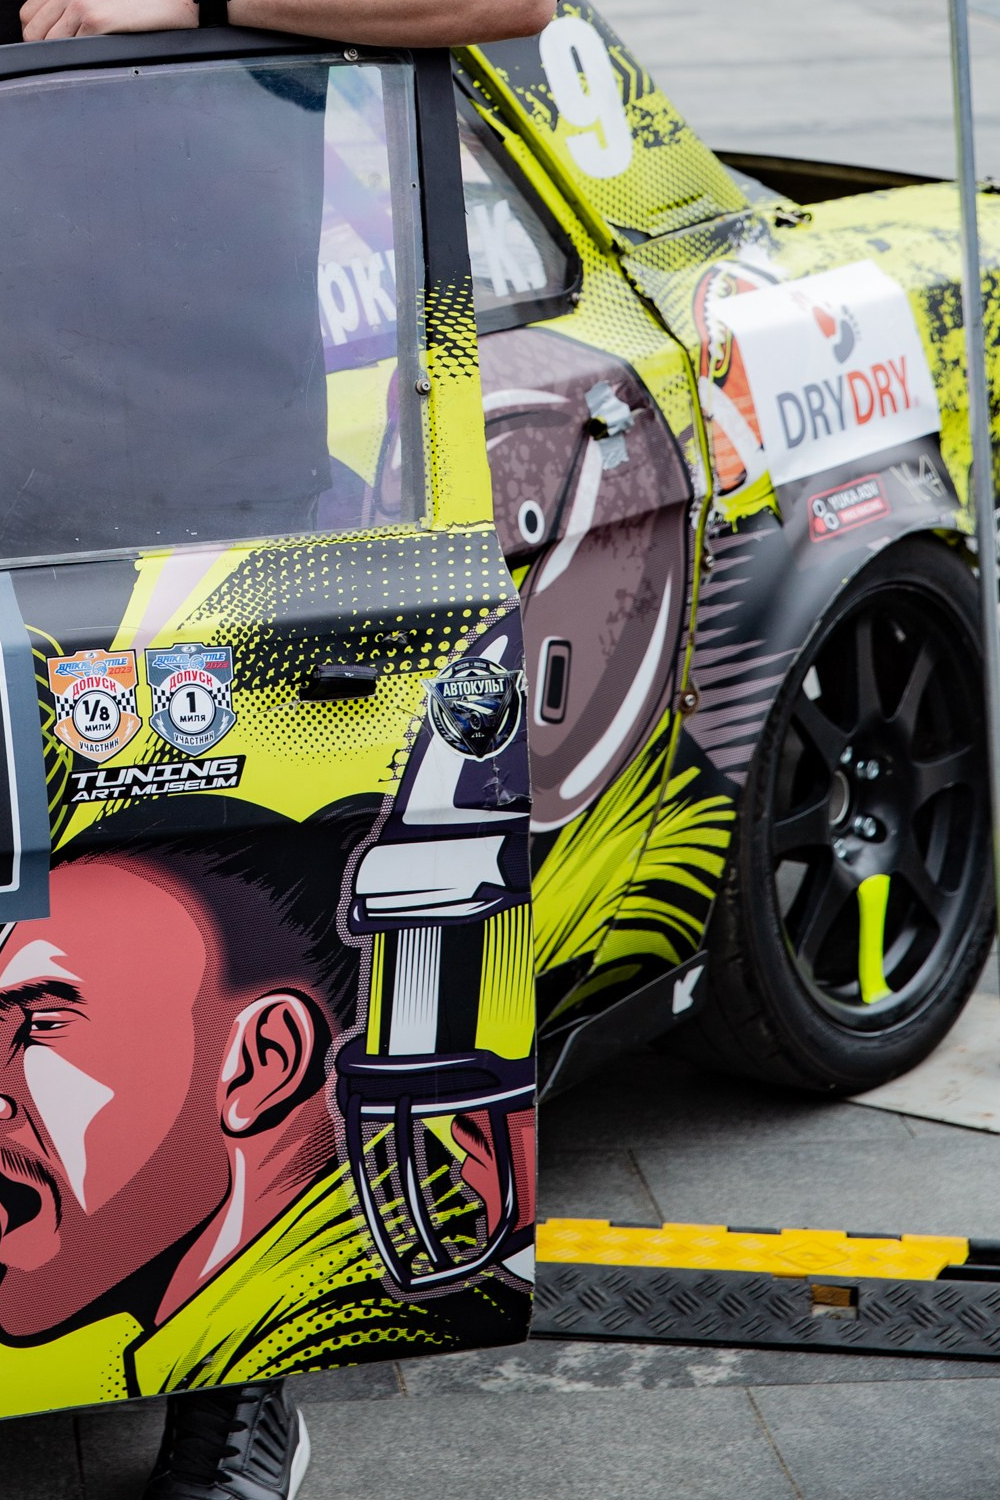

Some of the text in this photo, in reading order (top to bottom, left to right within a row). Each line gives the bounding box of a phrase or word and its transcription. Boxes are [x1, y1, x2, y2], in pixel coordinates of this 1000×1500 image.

[539, 15, 633, 179] 9
[108, 666, 133, 676] 2023
[205, 661, 229, 670] 2023
[72, 676, 117, 698] ДОПУСК
[169, 670, 214, 691] ДОПУСК
[443, 678, 505, 697] АВТОКУЛЬТ
[82, 699, 110, 722] 1/8
[186, 691, 197, 713] 1
[84, 723, 112, 733] МИЛИ
[179, 714, 206, 723] МИЛЯ
[79, 739, 120, 753] УЧАСТНИК
[174, 732, 215, 746] УЧАСТНИК
[71, 758, 239, 789] TUNING
[71, 776, 237, 802] ART MUSEUM
